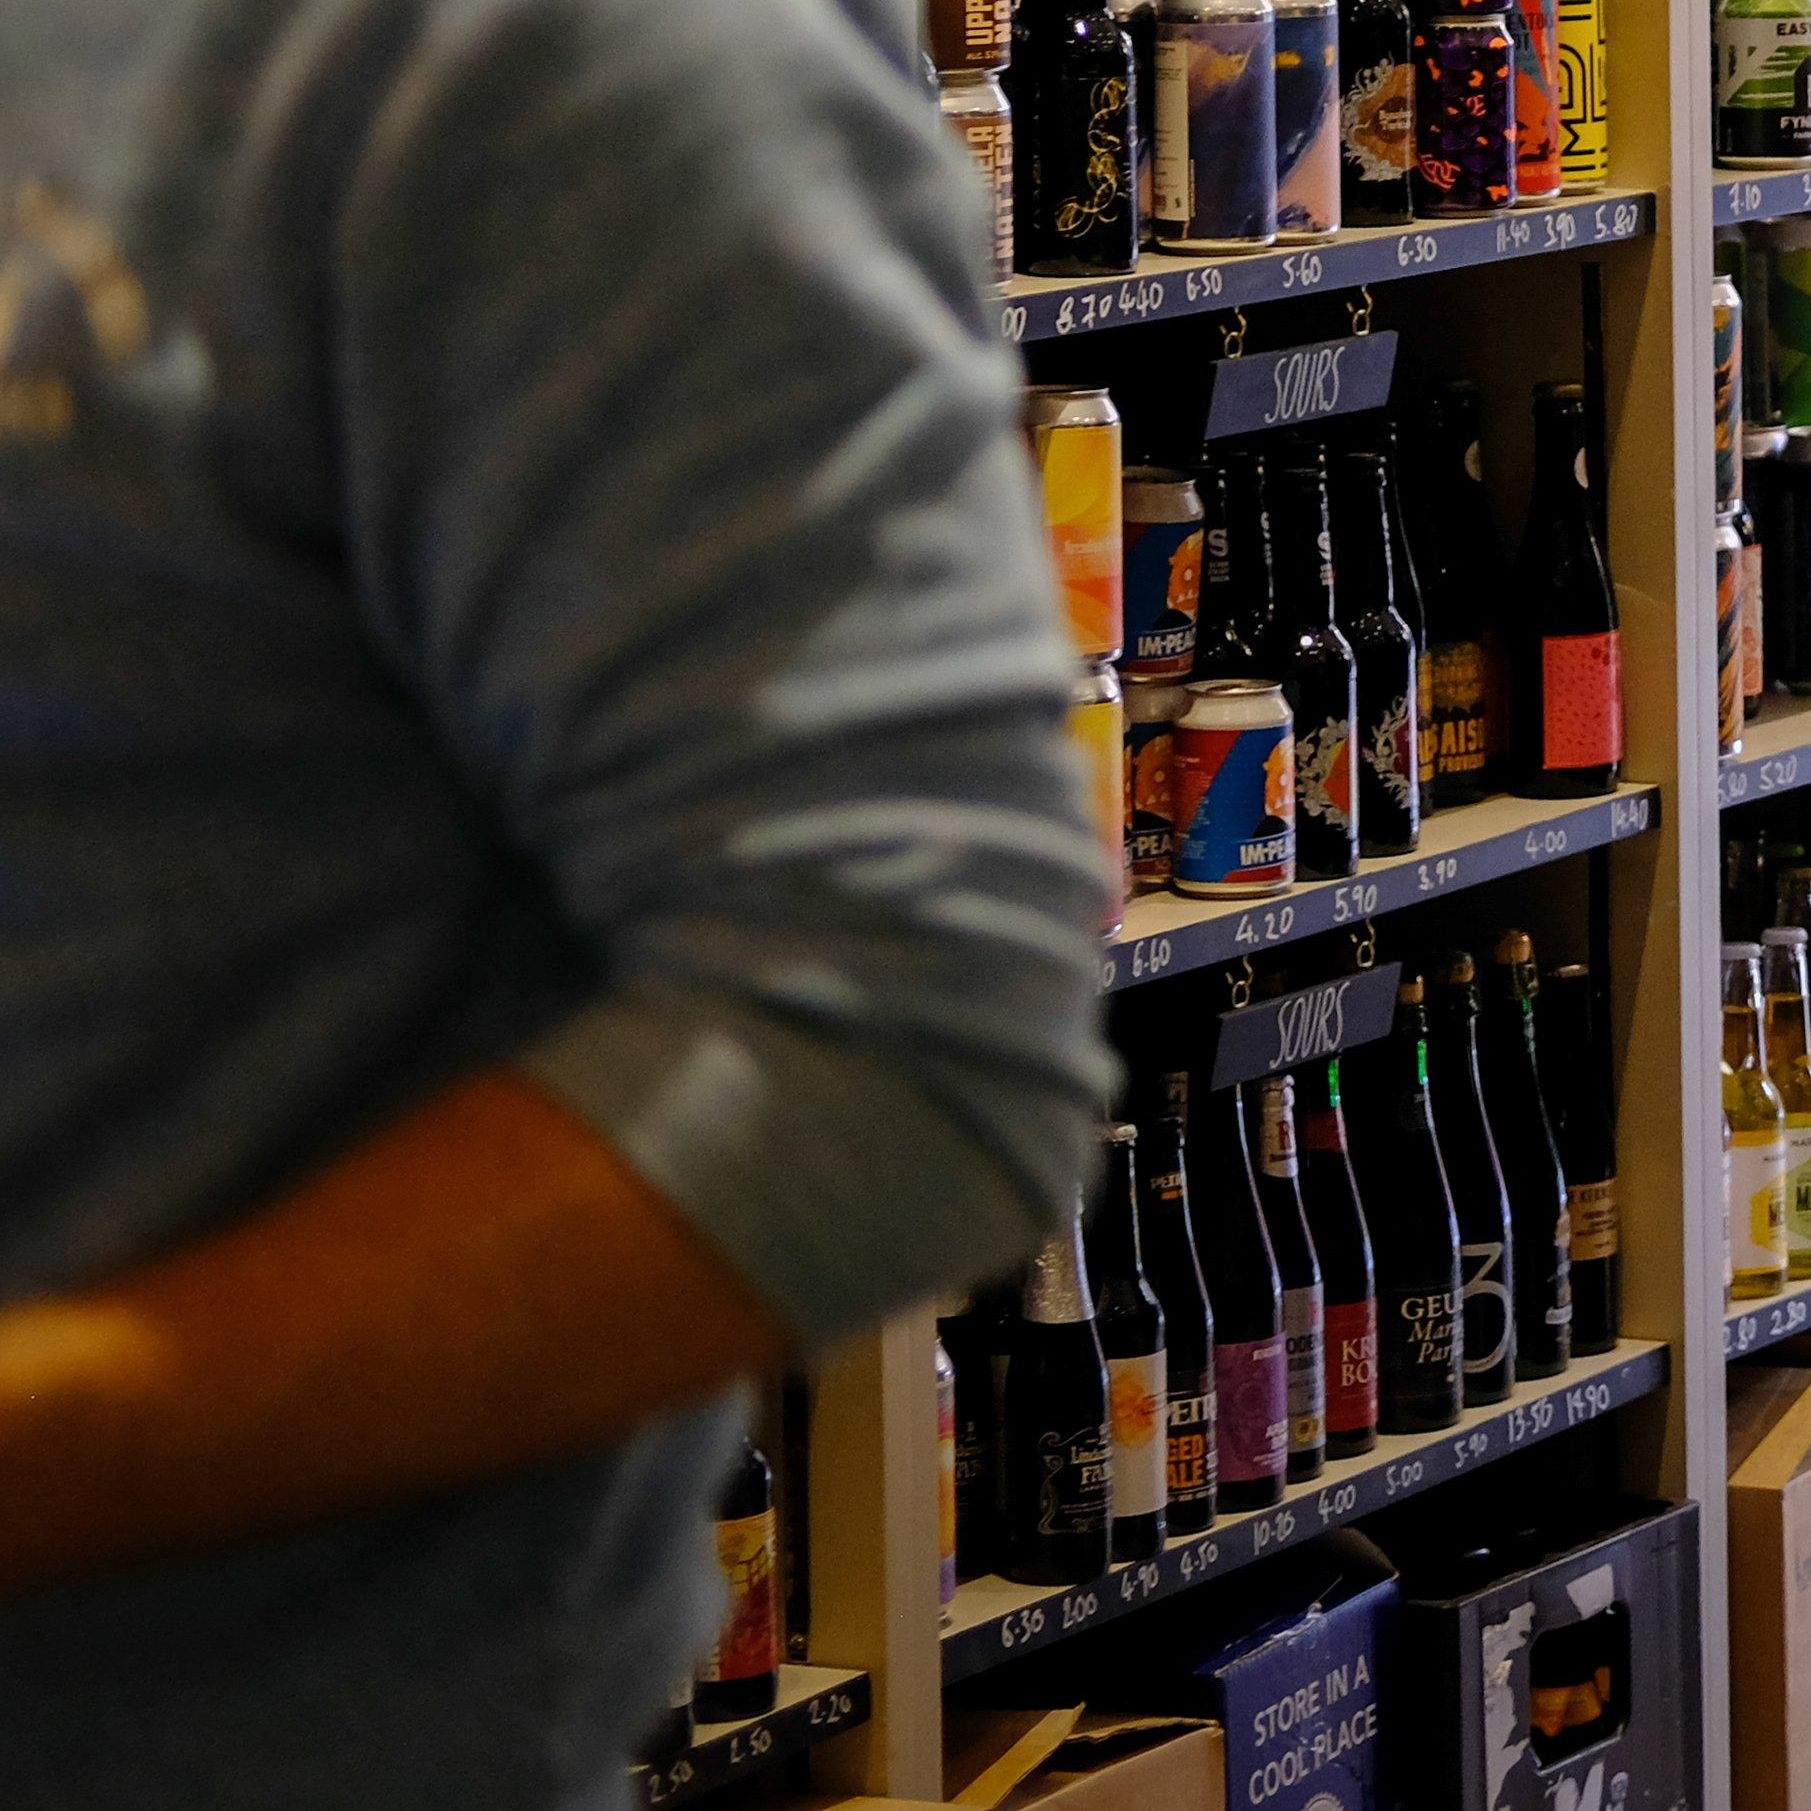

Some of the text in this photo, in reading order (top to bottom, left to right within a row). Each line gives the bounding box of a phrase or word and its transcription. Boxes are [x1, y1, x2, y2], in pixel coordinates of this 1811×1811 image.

[1264, 345, 1346, 426] SOURS
[1268, 981, 1351, 1070] SOURS
[1253, 1653, 1371, 1748] STORE IN A
[1248, 1702, 1379, 1806] COOL PLACE
